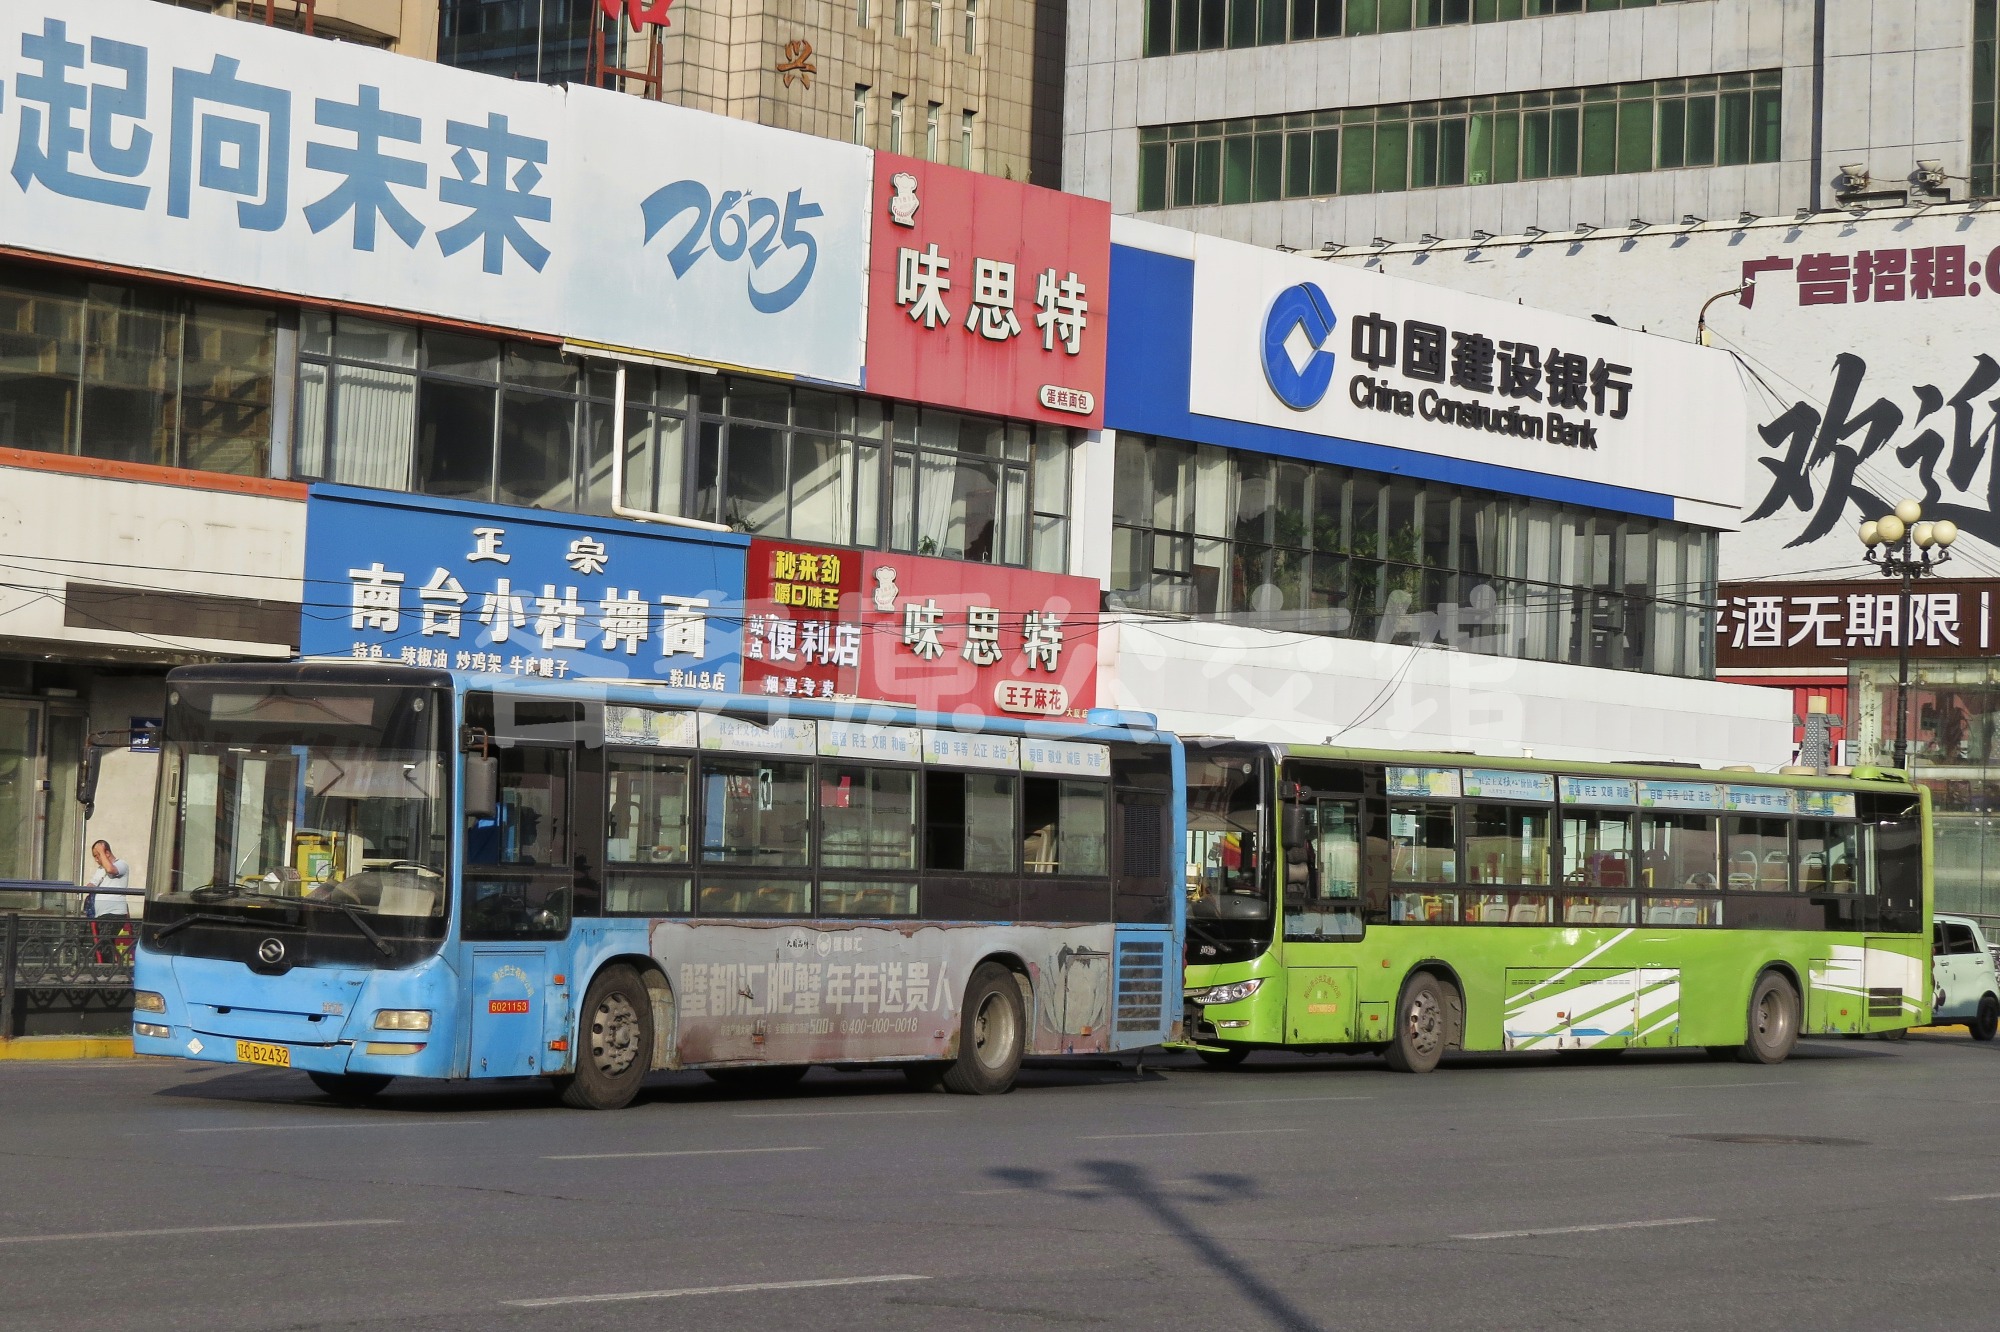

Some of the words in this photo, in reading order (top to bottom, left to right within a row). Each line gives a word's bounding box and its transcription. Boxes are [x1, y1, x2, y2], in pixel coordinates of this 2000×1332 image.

[0, 17, 552, 275] 起向未来
[640, 179, 824, 314] 2025
[895, 243, 1088, 355] 味思特
[1351, 312, 1632, 420] 中国建设银行
[1046, 388, 1088, 410] 蛋糕面包
[1349, 374, 1415, 418] China
[1418, 388, 1543, 441] Construction
[1546, 412, 1598, 451] Bank
[1741, 352, 2000, 552] 欢迎
[774, 551, 841, 585] 秒来劲
[348, 562, 710, 659] 南台小杜抻面
[773, 582, 840, 609] 嚼口味王
[750, 614, 765, 659] 站点
[767, 618, 861, 667] 便利店
[903, 598, 1064, 673] 味思特
[1717, 593, 1963, 649] 酒无期限
[401, 645, 448, 668] 辣椒油
[456, 650, 502, 673] 炒鸡架
[669, 668, 726, 691] 鞍山总店
[765, 675, 835, 698] 烟草专卖
[1005, 686, 1062, 710] 王子麻花
[934, 740, 949, 755] 自由
[973, 743, 988, 758] 公正
[491, 1002, 527, 1012] 6021153
